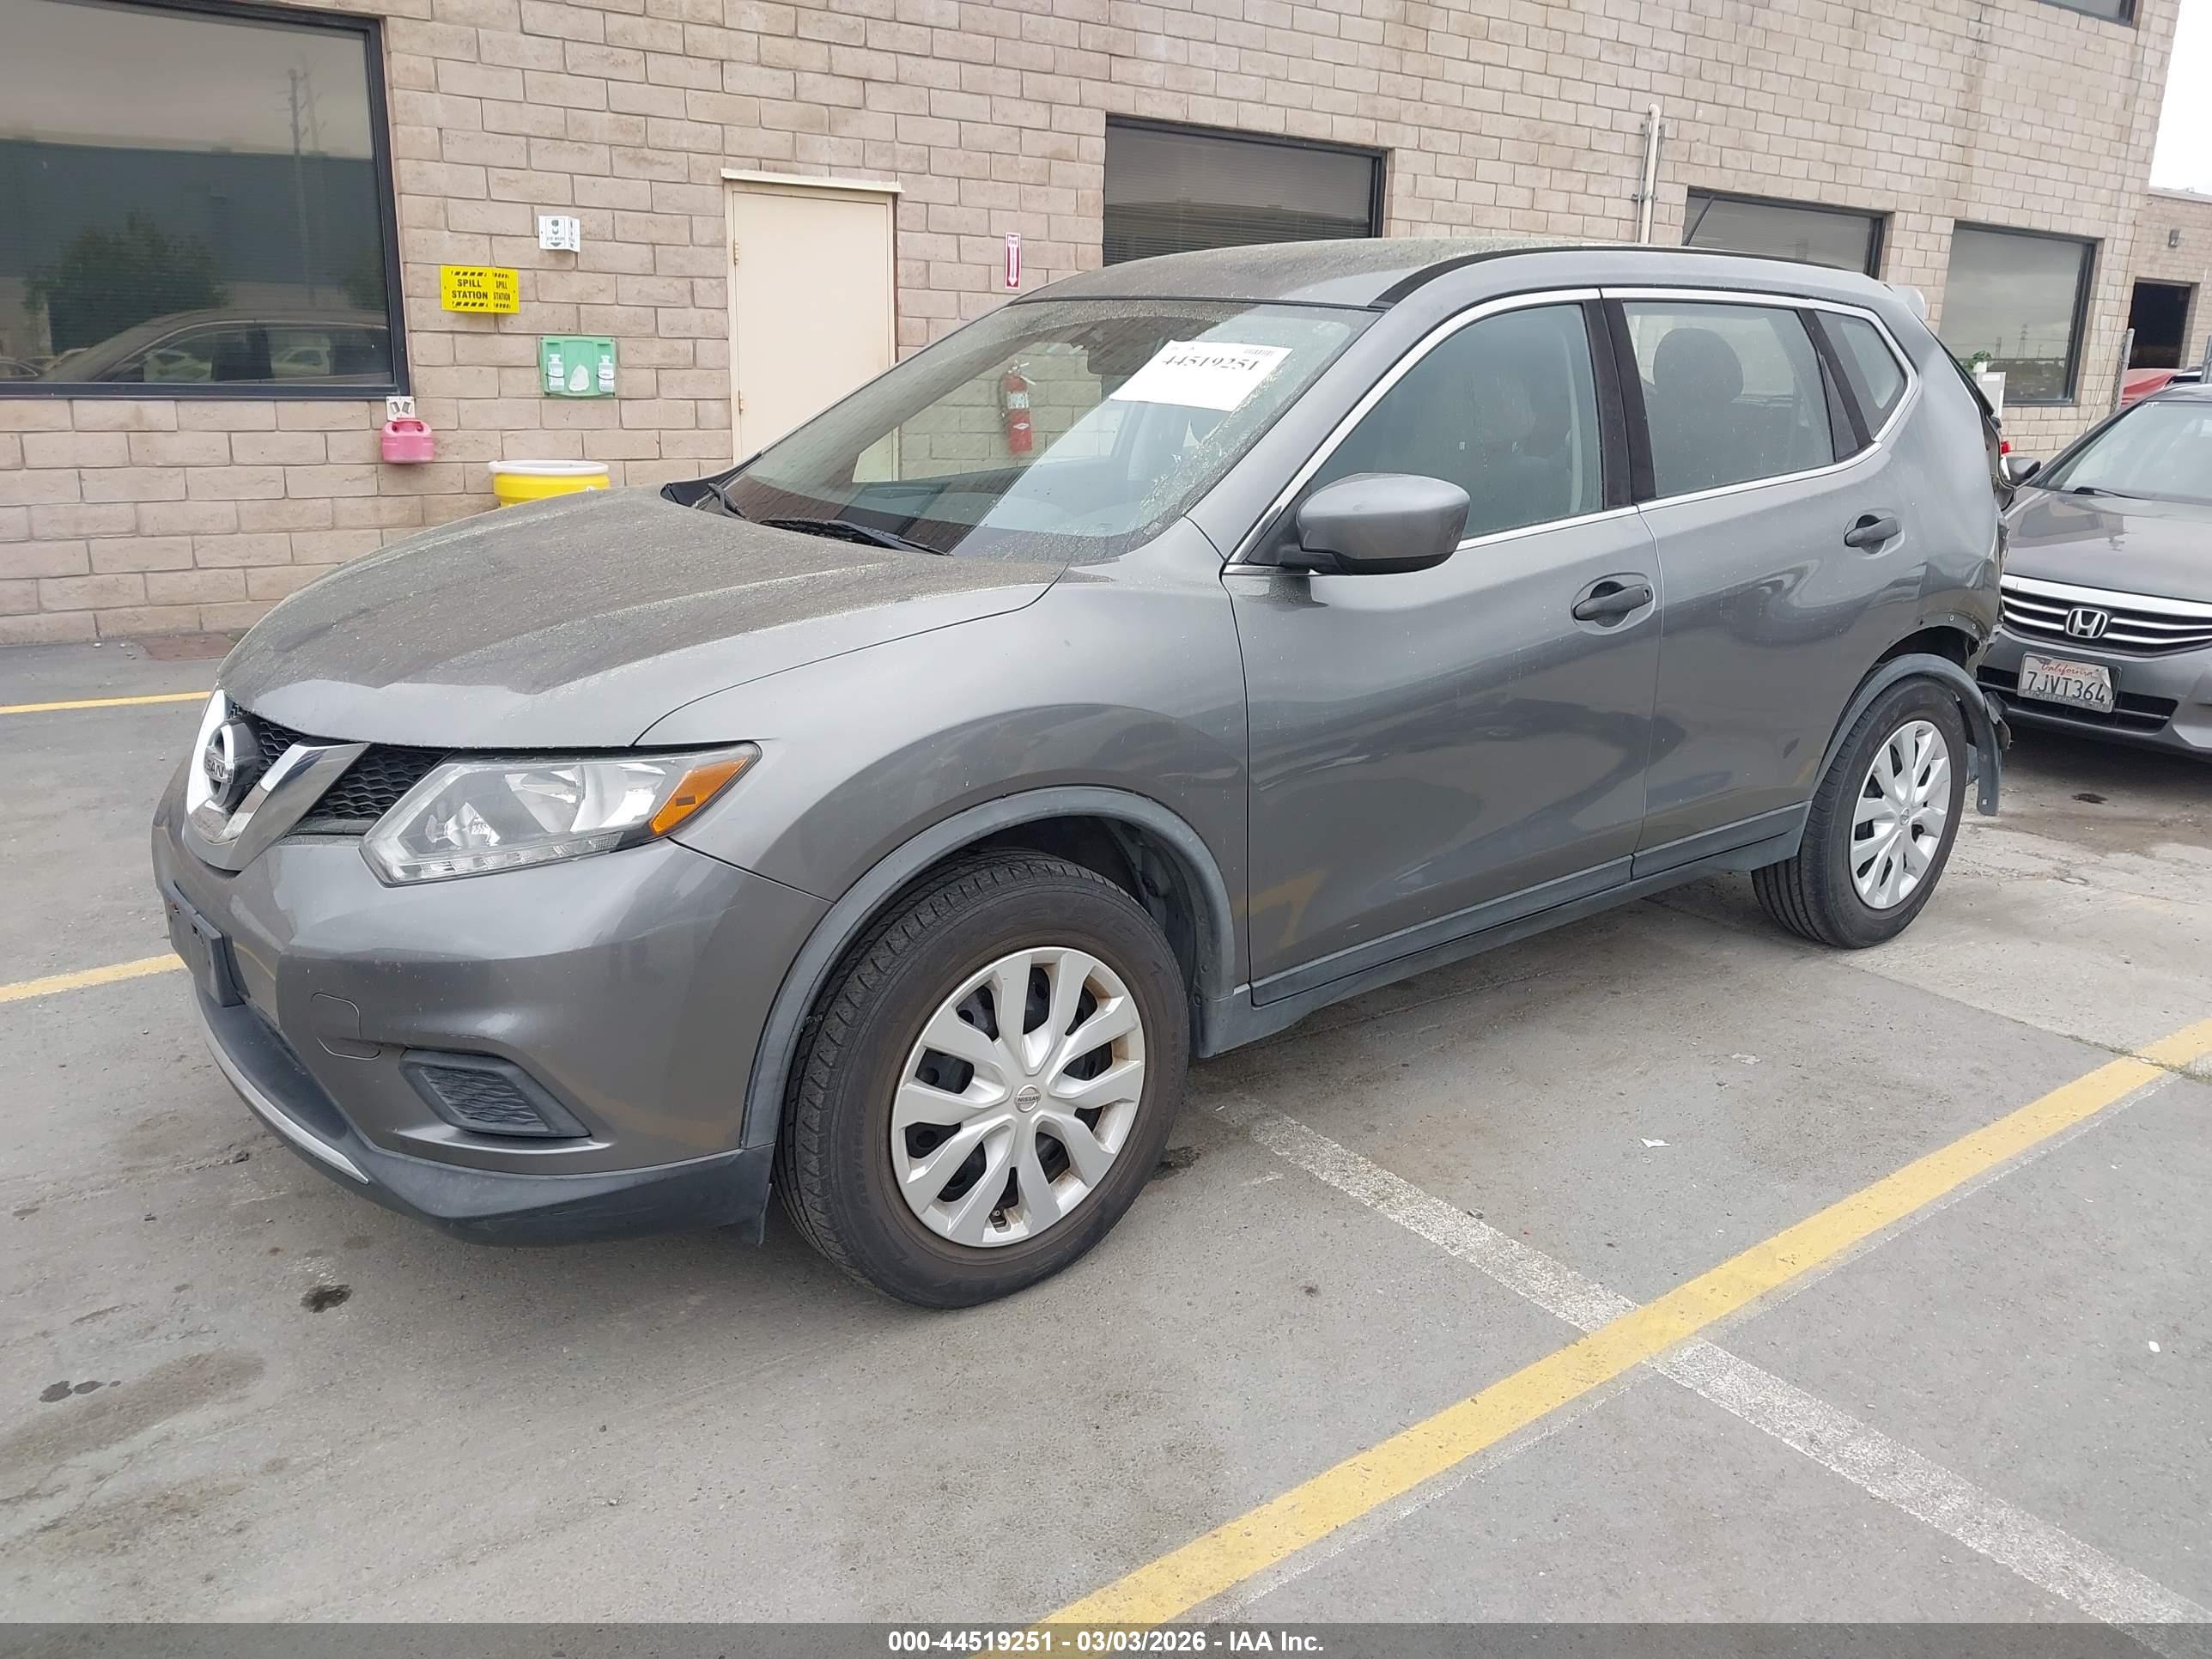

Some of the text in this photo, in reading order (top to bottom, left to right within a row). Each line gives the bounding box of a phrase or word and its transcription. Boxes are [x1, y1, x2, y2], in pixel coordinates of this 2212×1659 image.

[457, 278, 482, 288] SPILL
[495, 280, 508, 289] SPILL
[452, 289, 488, 300] STATION
[493, 291, 511, 301] STATION
[1162, 355, 1261, 371] 44519251
[2041, 663, 2094, 677] California
[2027, 671, 2106, 703] 7JVT364
